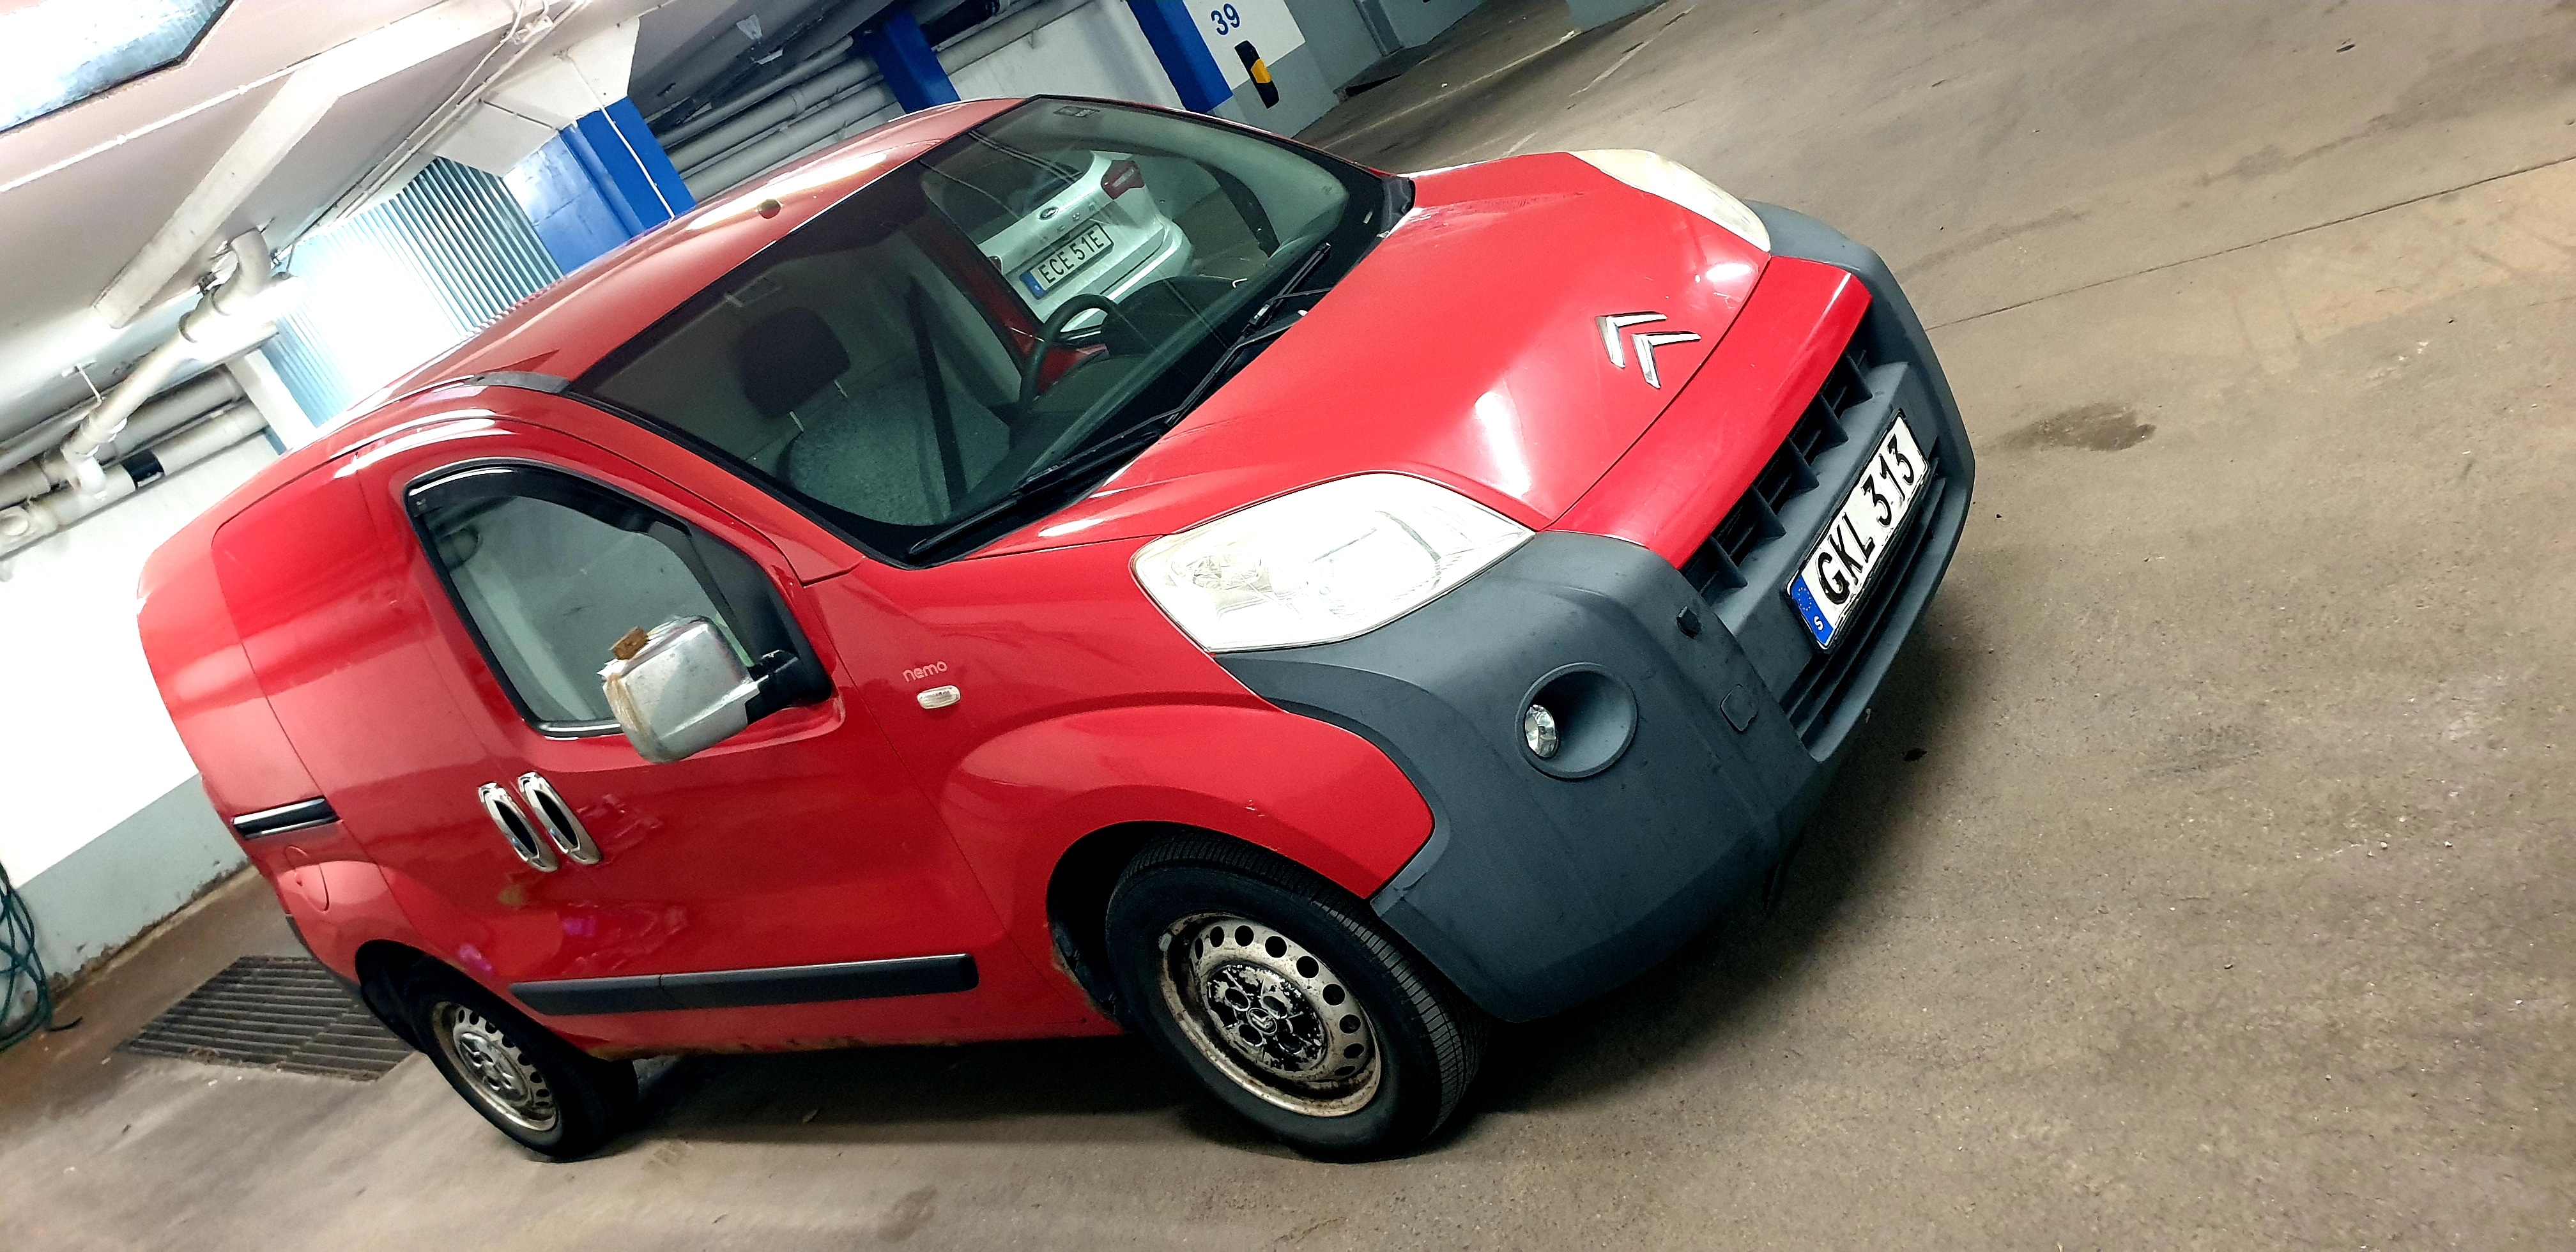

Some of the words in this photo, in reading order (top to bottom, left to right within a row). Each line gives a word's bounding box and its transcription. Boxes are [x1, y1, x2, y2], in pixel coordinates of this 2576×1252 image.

[1211, 3, 1240, 35] 39
[1038, 251, 1075, 284] ECE
[1070, 230, 1105, 261] 51E
[1817, 512, 1875, 604] GKL
[1861, 434, 1914, 526] 313
[1813, 616, 1825, 631] S
[903, 661, 947, 682] nemo
